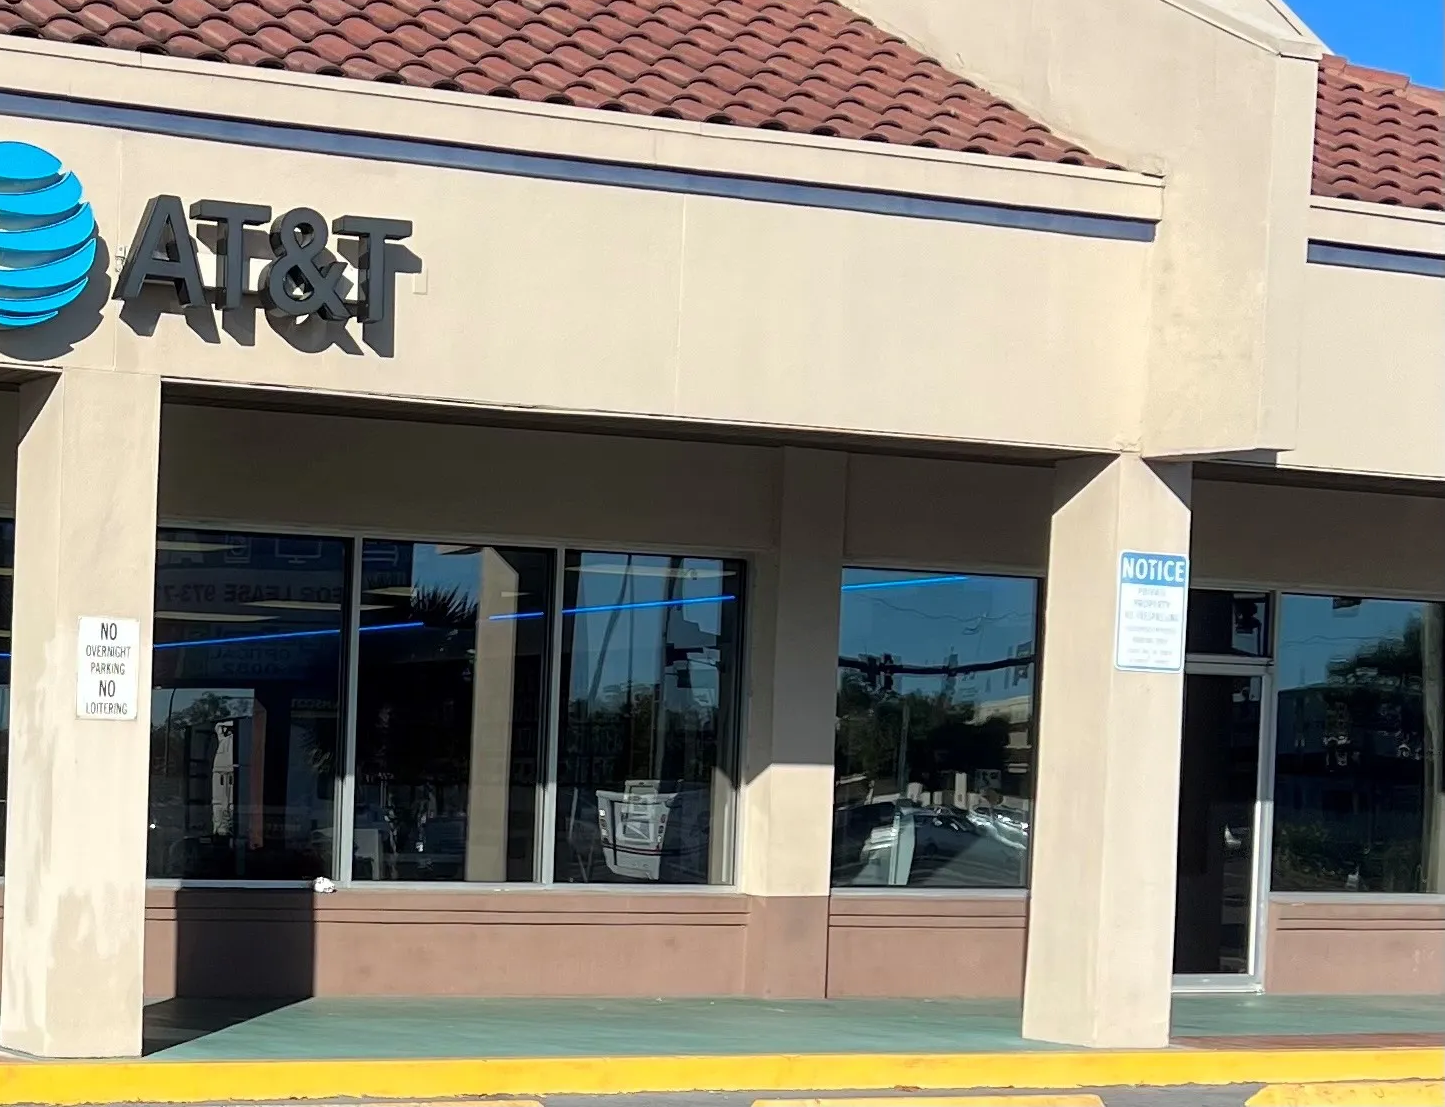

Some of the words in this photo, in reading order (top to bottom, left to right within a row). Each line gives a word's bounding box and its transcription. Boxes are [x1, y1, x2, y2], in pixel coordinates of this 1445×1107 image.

[112, 195, 412, 323] AT&T
[1122, 557, 1185, 582] NOTICE
[100, 622, 117, 640] NO
[85, 644, 131, 658] OVERNIGHT
[90, 661, 126, 675] PARKING
[99, 679, 116, 697] NO
[85, 701, 128, 715] LOITERING
